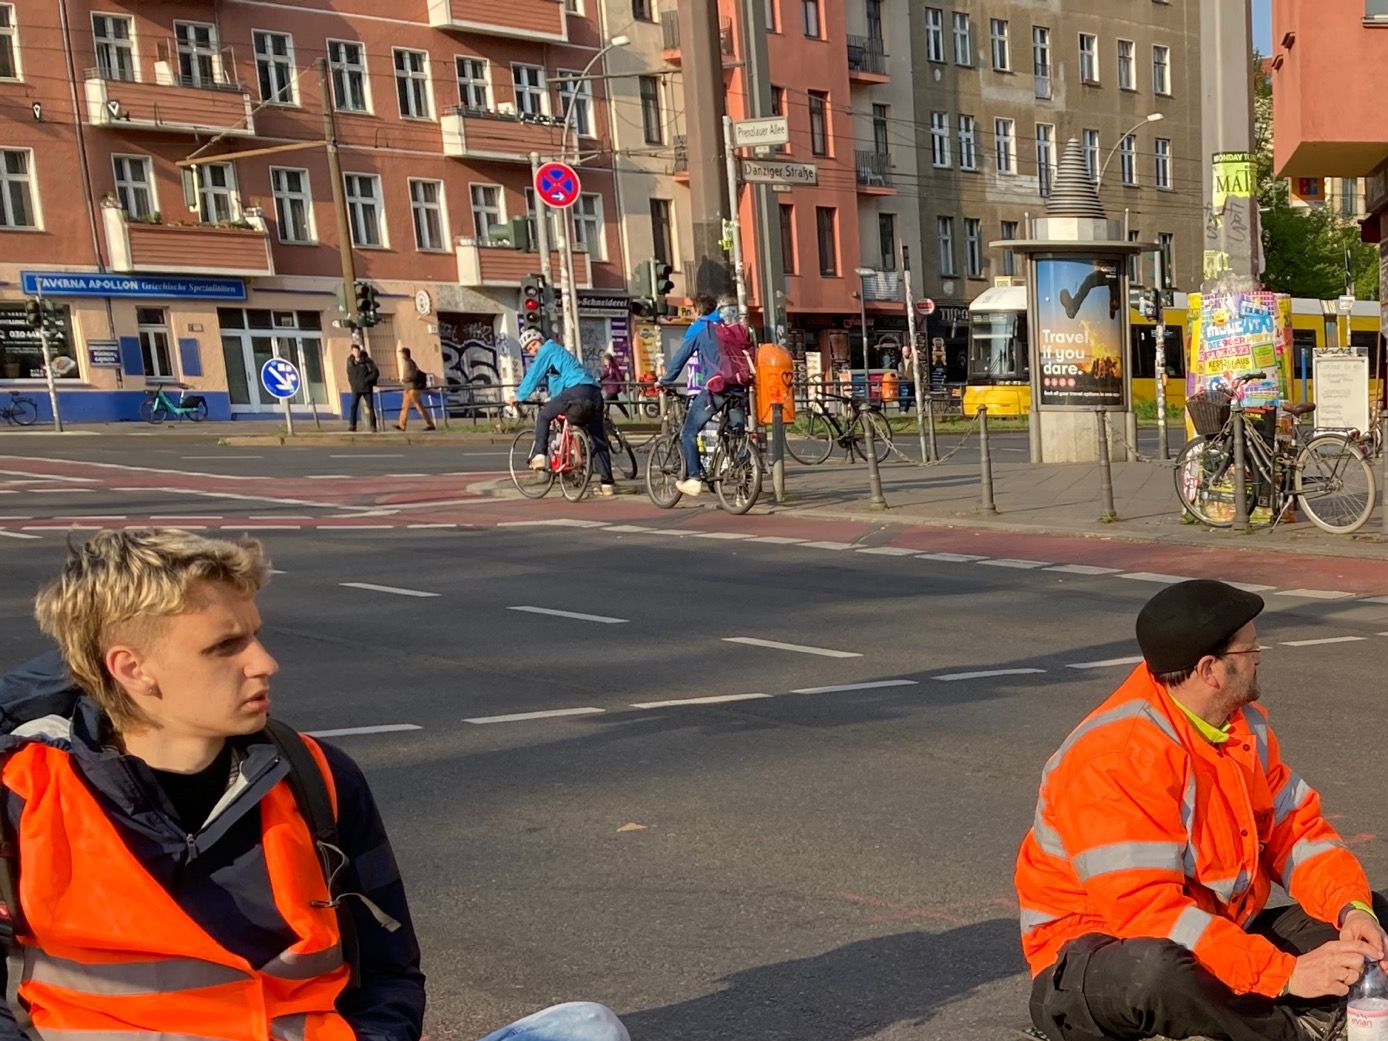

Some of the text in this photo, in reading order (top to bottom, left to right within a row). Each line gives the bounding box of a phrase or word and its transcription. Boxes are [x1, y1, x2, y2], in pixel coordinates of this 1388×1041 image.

[737, 124, 785, 137] Prenzlauer Allee
[744, 163, 814, 180] Danziger Straße
[35, 277, 86, 289] TAVERNA
[88, 279, 138, 290] APOLLON
[1042, 329, 1089, 343] Travel
[1043, 345, 1085, 362] if you
[1043, 361, 1084, 375] dare.
[1351, 1018, 1373, 1029] evian
